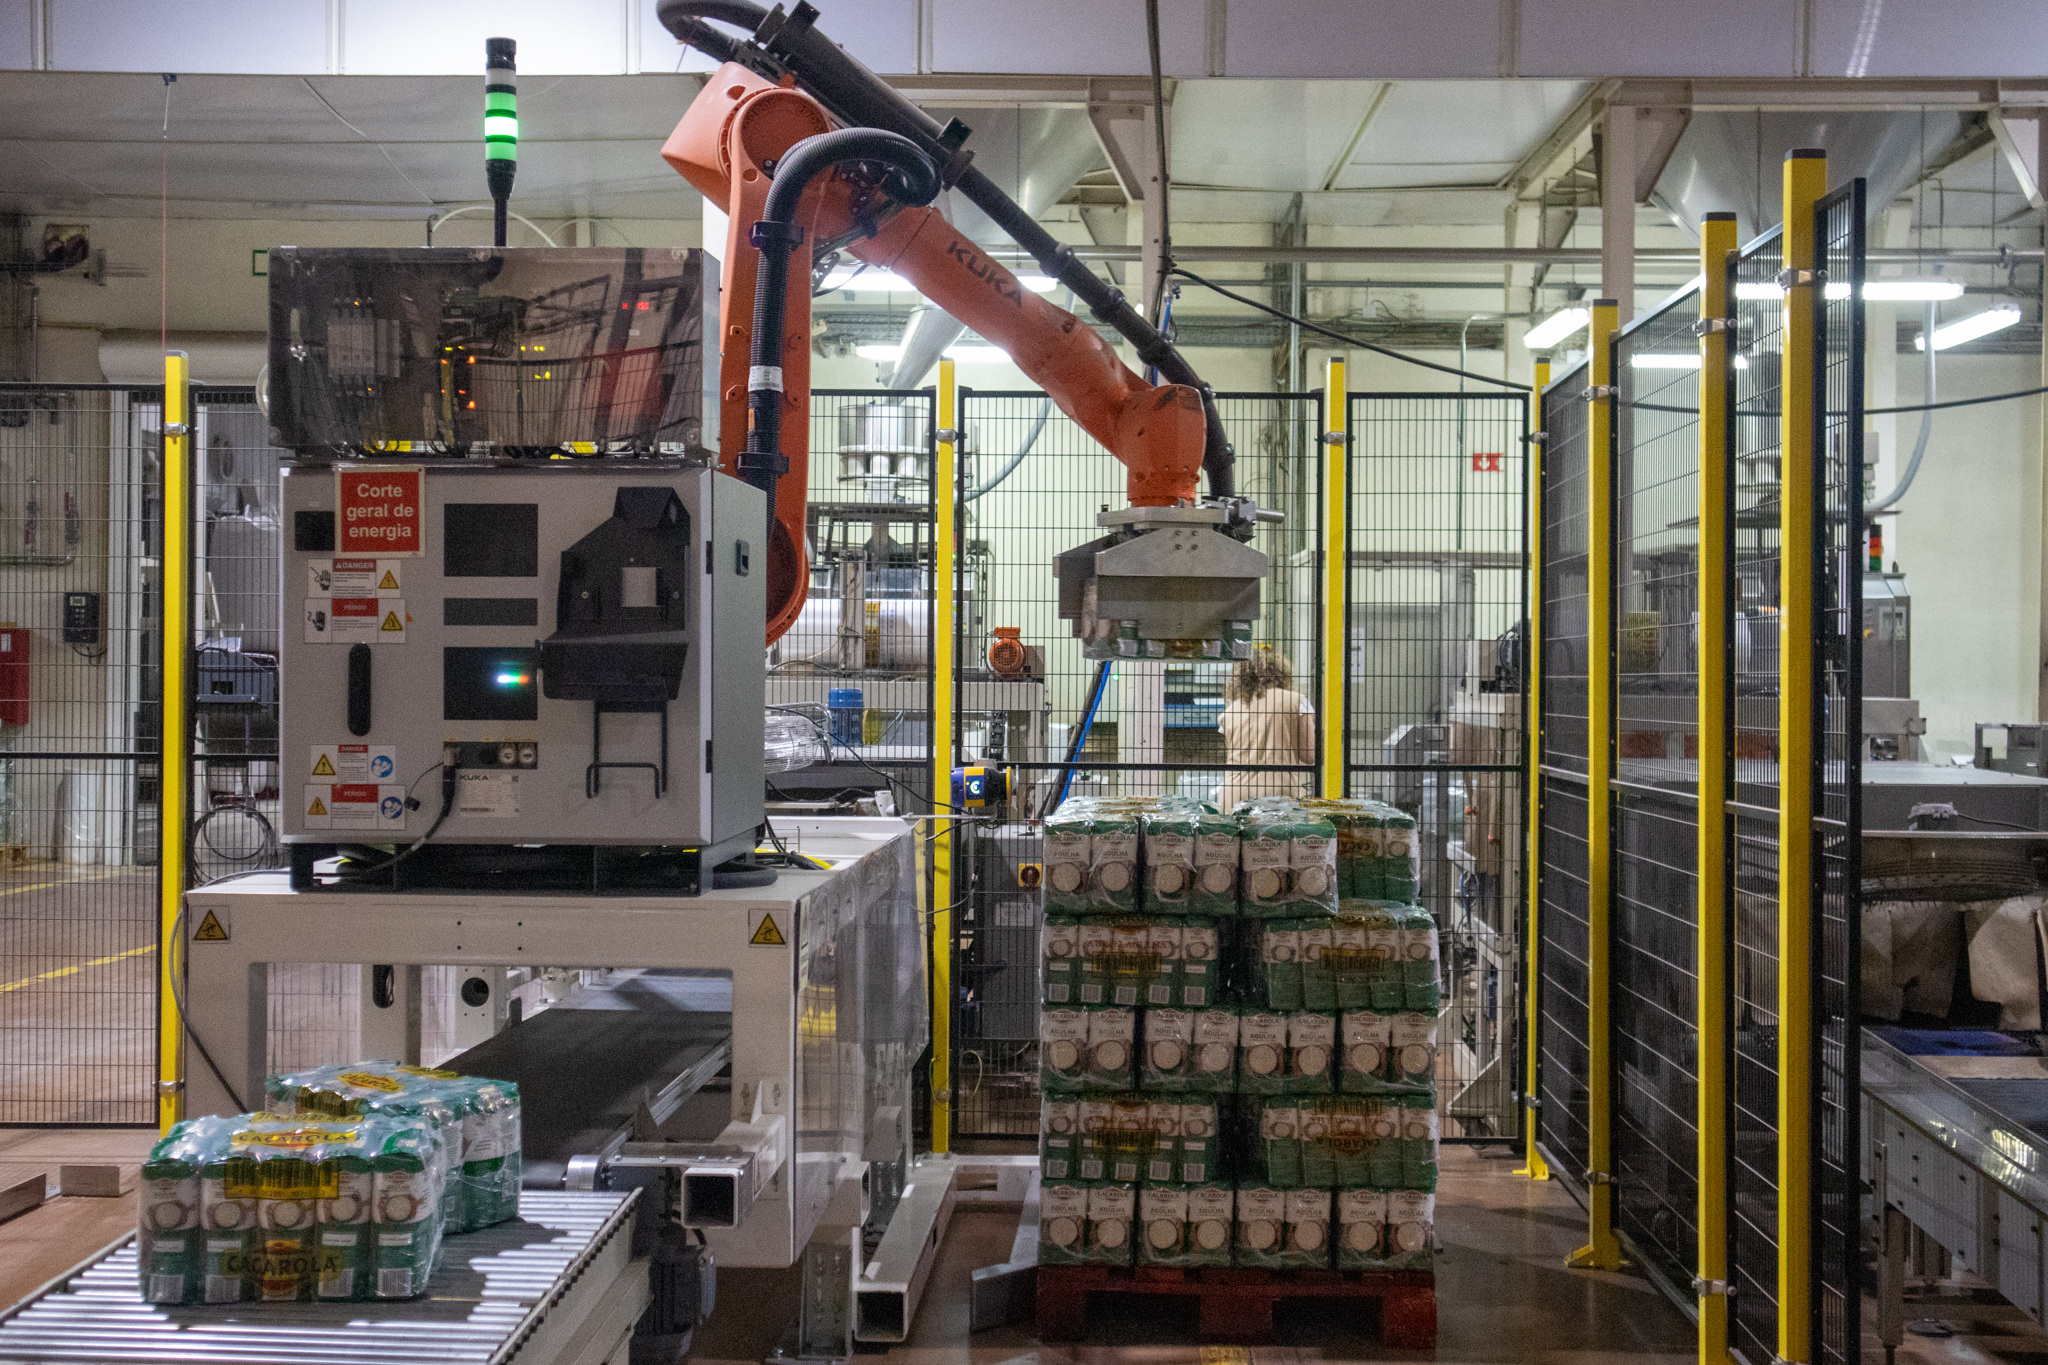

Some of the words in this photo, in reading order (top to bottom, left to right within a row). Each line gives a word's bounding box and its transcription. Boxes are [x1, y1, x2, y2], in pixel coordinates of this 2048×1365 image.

[948, 240, 1022, 309] KUKA
[357, 483, 403, 498] Corte
[346, 503, 388, 521] geral
[393, 503, 414, 517] de
[349, 523, 411, 541] energia
